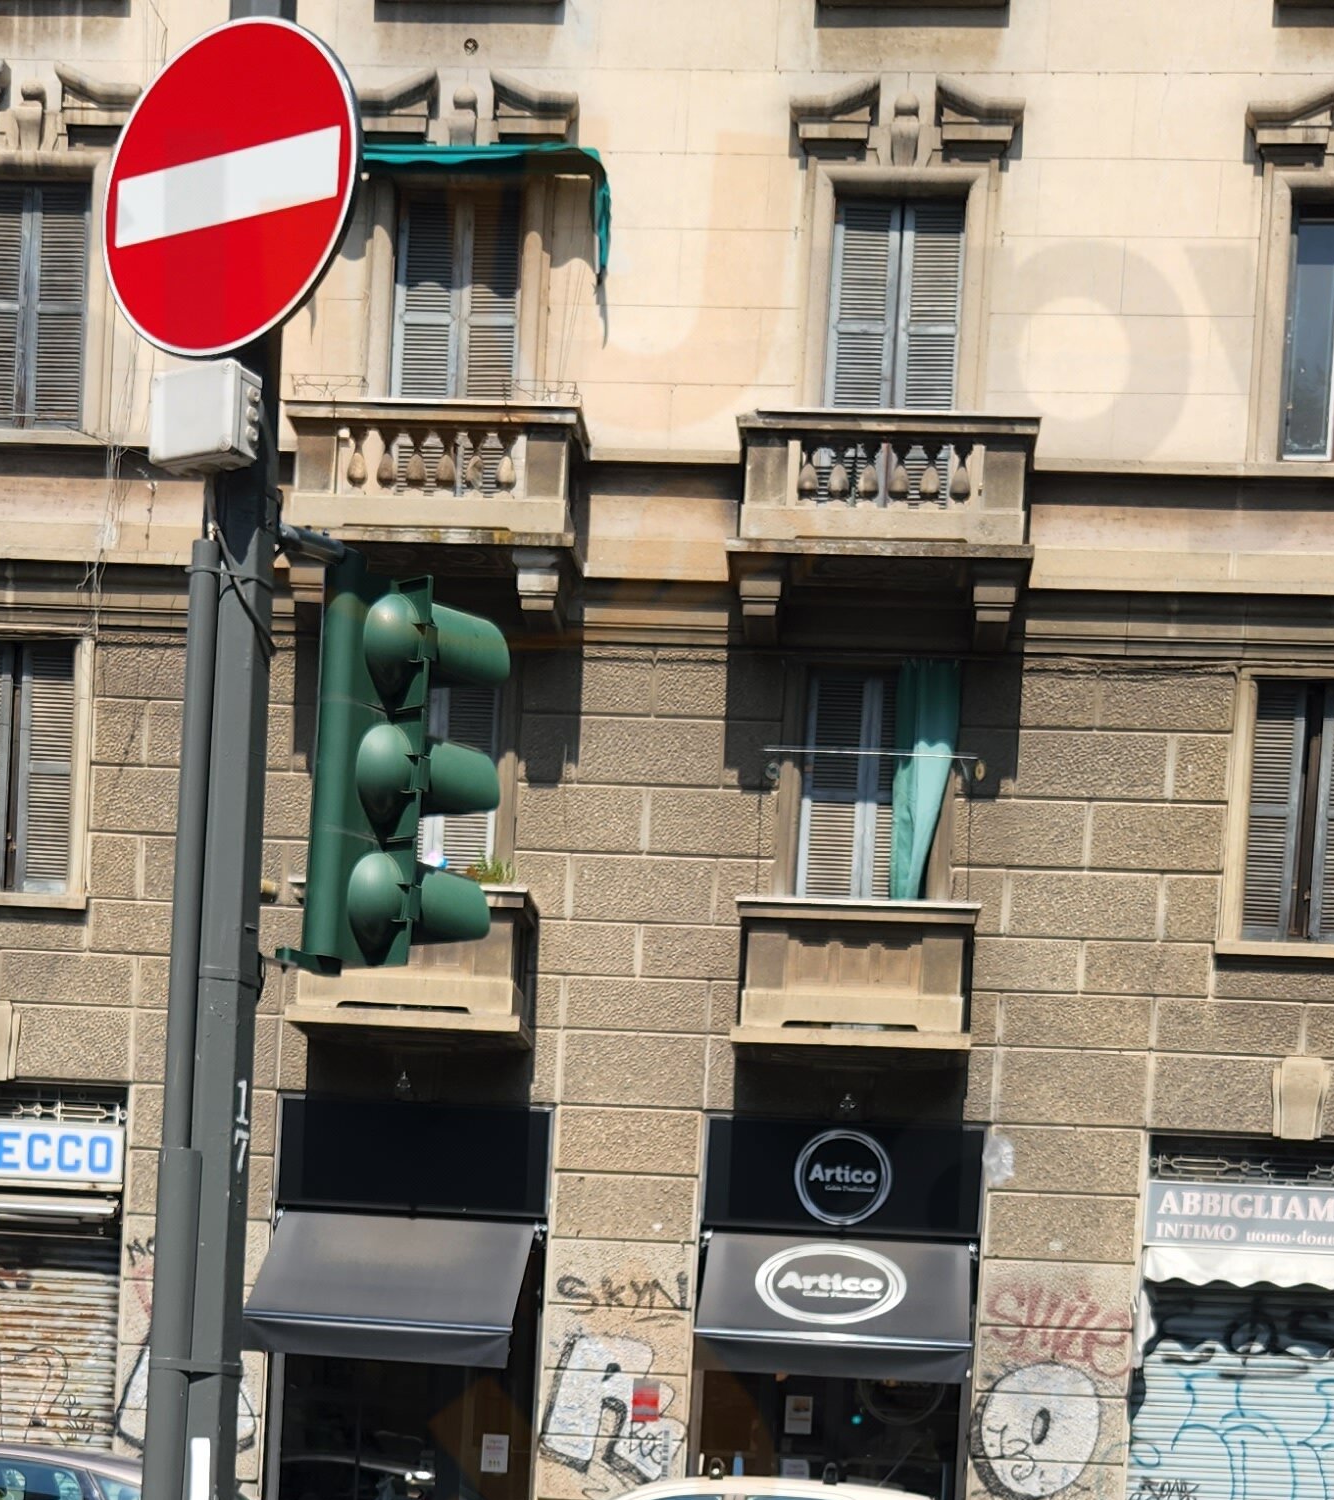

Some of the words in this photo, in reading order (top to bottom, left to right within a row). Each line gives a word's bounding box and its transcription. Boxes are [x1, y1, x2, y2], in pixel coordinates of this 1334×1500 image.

[808, 1163, 877, 1184] Artico
[1155, 1221, 1237, 1241] INTIMO
[777, 1271, 884, 1292] Artico
